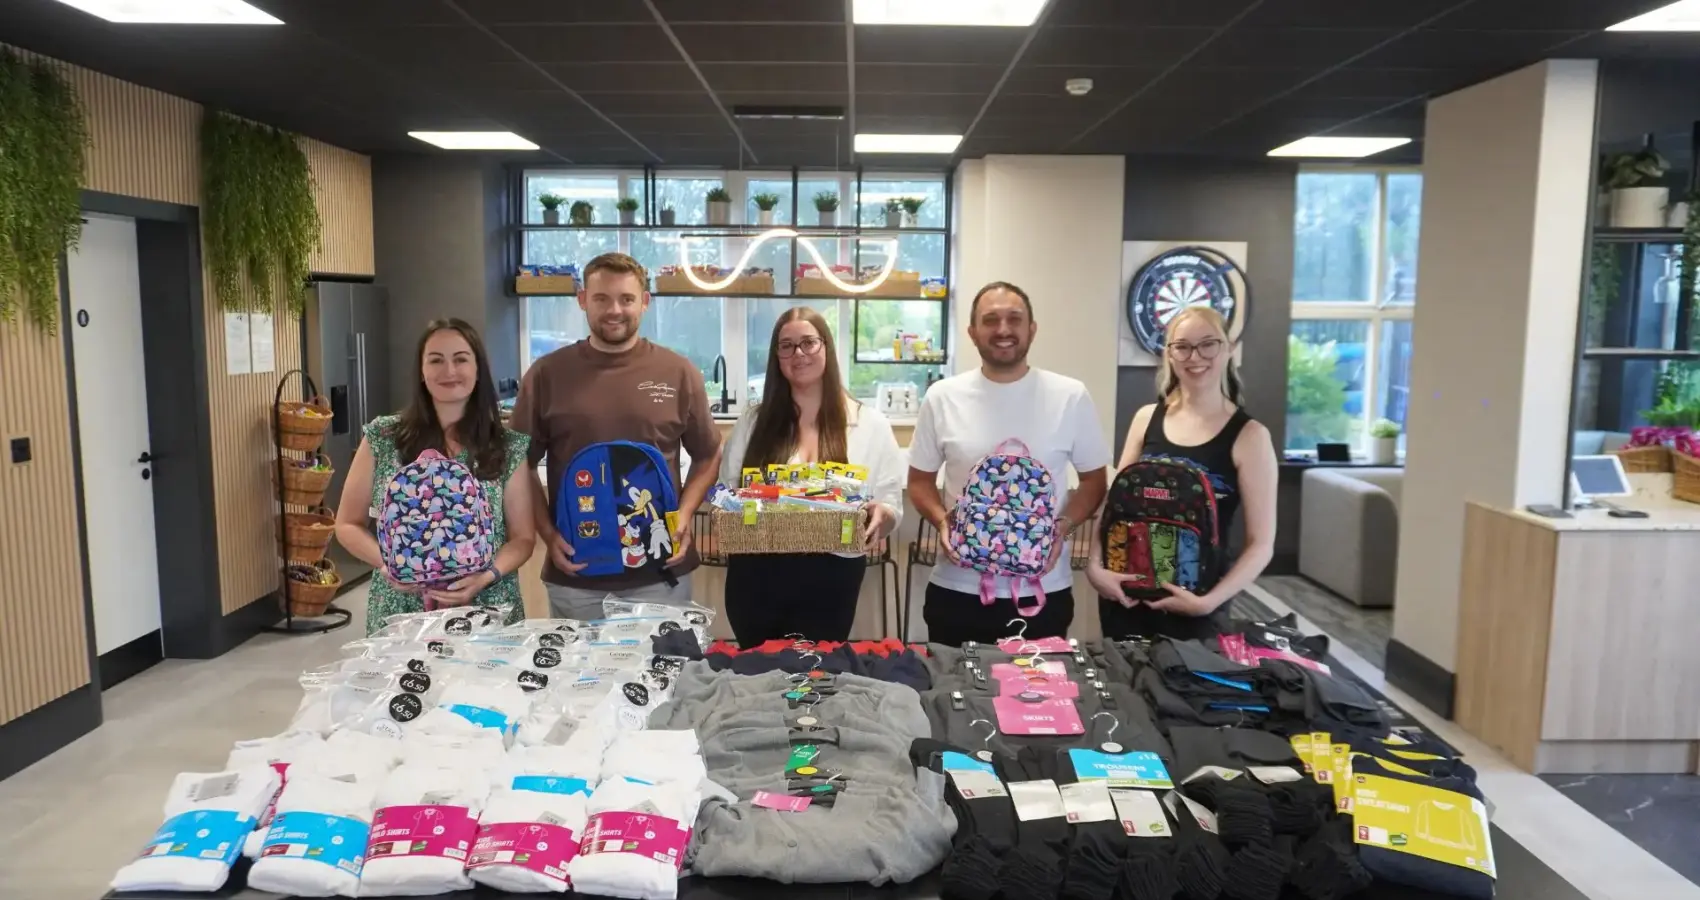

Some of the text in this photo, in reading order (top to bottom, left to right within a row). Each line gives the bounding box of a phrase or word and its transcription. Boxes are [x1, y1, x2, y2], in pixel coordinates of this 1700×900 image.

[1143, 487, 1170, 499] MARVEL
[402, 679, 425, 692] £6.50
[408, 698, 420, 709] PACK
[391, 702, 414, 719] £6.50
[1022, 714, 1056, 722] SKIRTS
[1093, 763, 1148, 772] TROUSERS
[1357, 797, 1411, 813] SWEATSHIRT
[386, 828, 411, 837] SHIRTS
[600, 829, 623, 837] SHIRTS
[491, 840, 515, 848] SHIRTS
